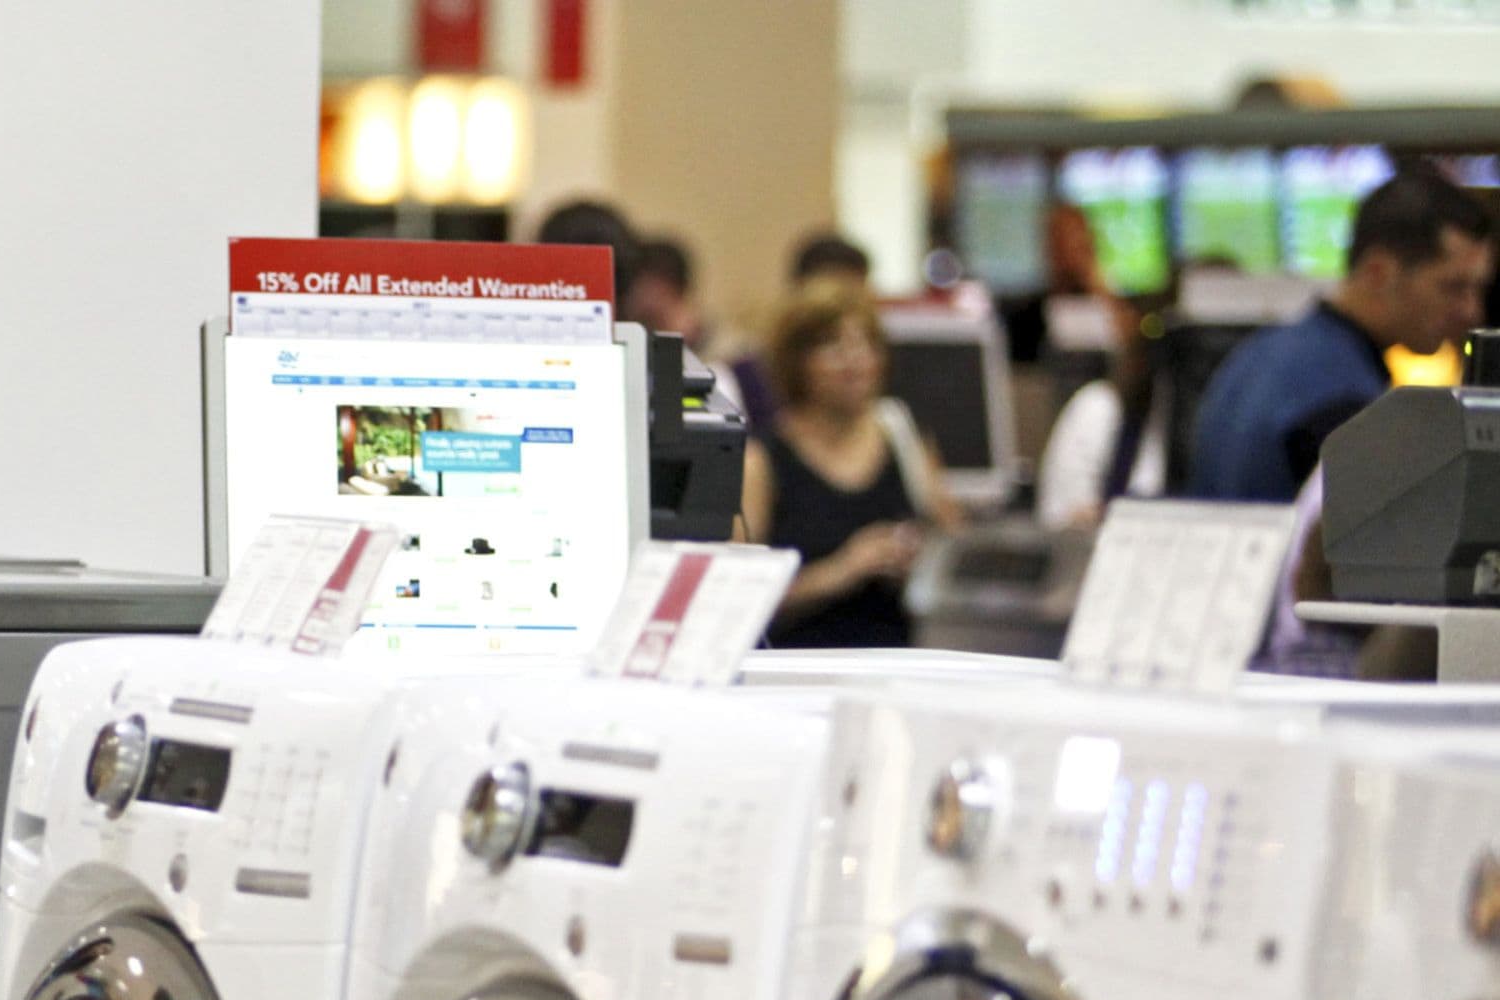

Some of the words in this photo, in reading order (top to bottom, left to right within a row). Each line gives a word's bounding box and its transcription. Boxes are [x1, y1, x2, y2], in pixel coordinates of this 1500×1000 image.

[256, 271, 299, 293] 15%
[304, 272, 340, 293] Off
[344, 272, 372, 294] All
[377, 274, 474, 297] Extended
[477, 276, 588, 300] Warranties
